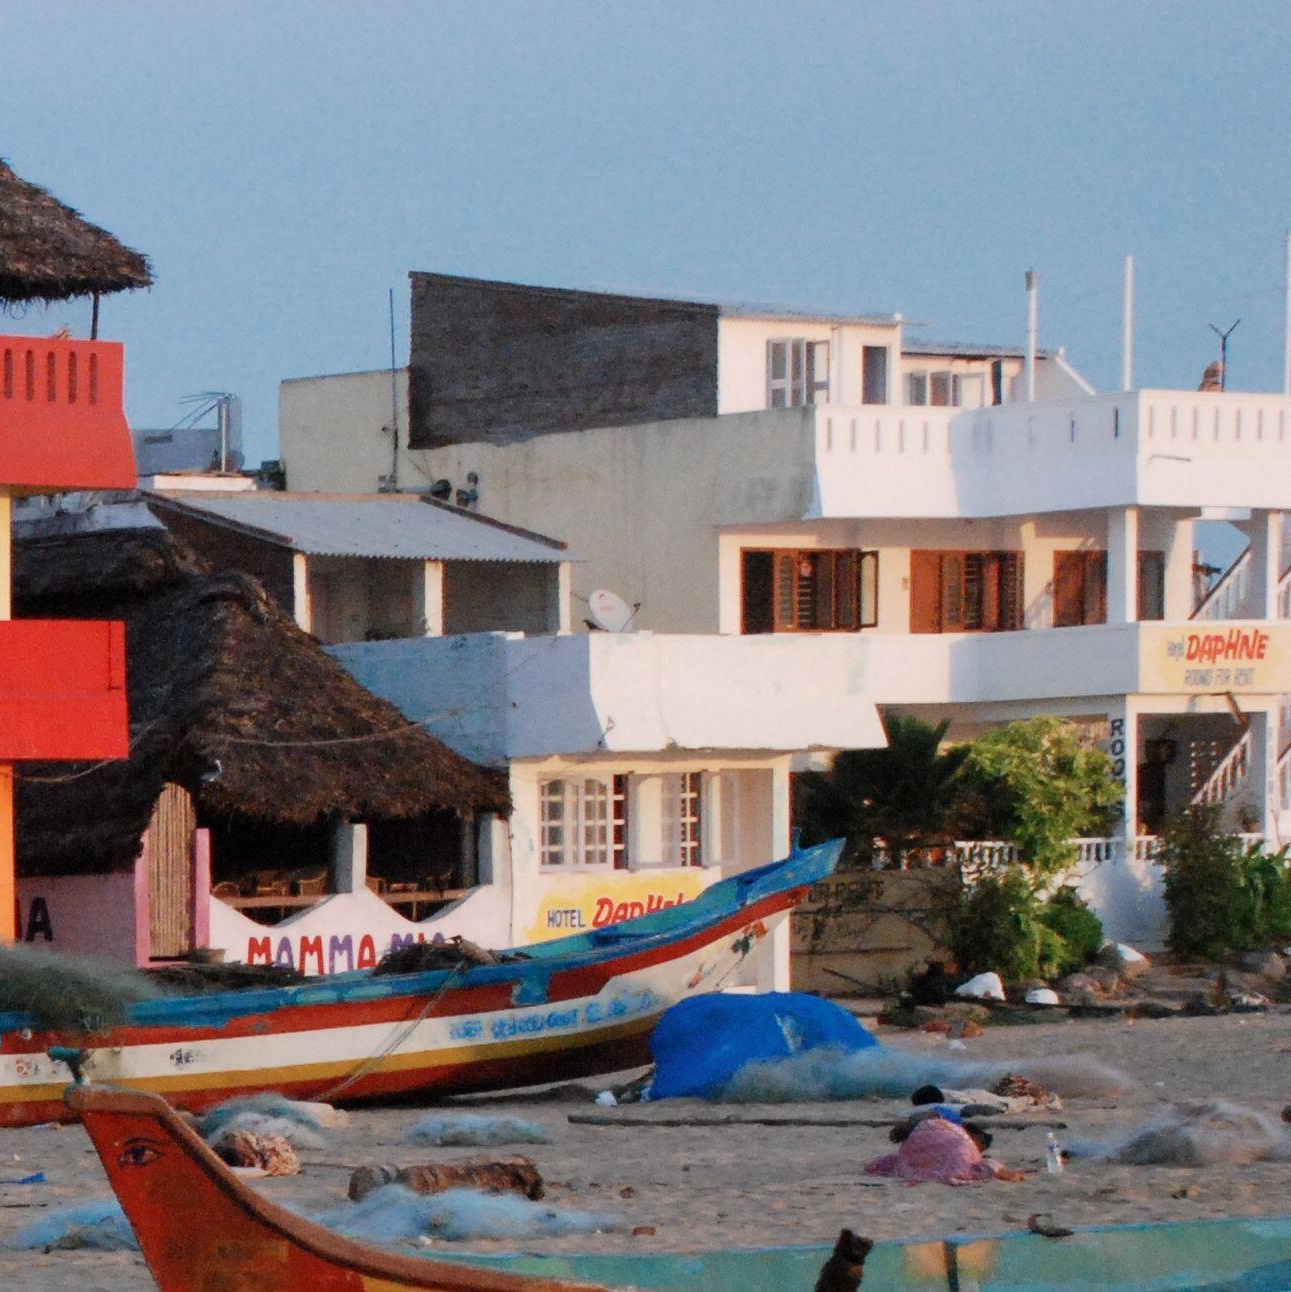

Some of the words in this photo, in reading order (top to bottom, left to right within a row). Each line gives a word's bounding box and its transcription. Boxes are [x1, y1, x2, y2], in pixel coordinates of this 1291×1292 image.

[1186, 629, 1269, 663] DAPHNE
[25, 897, 53, 942] A
[547, 909, 585, 928] HOTEL
[592, 892, 695, 928] DAPH
[247, 934, 377, 976] MAMMA
